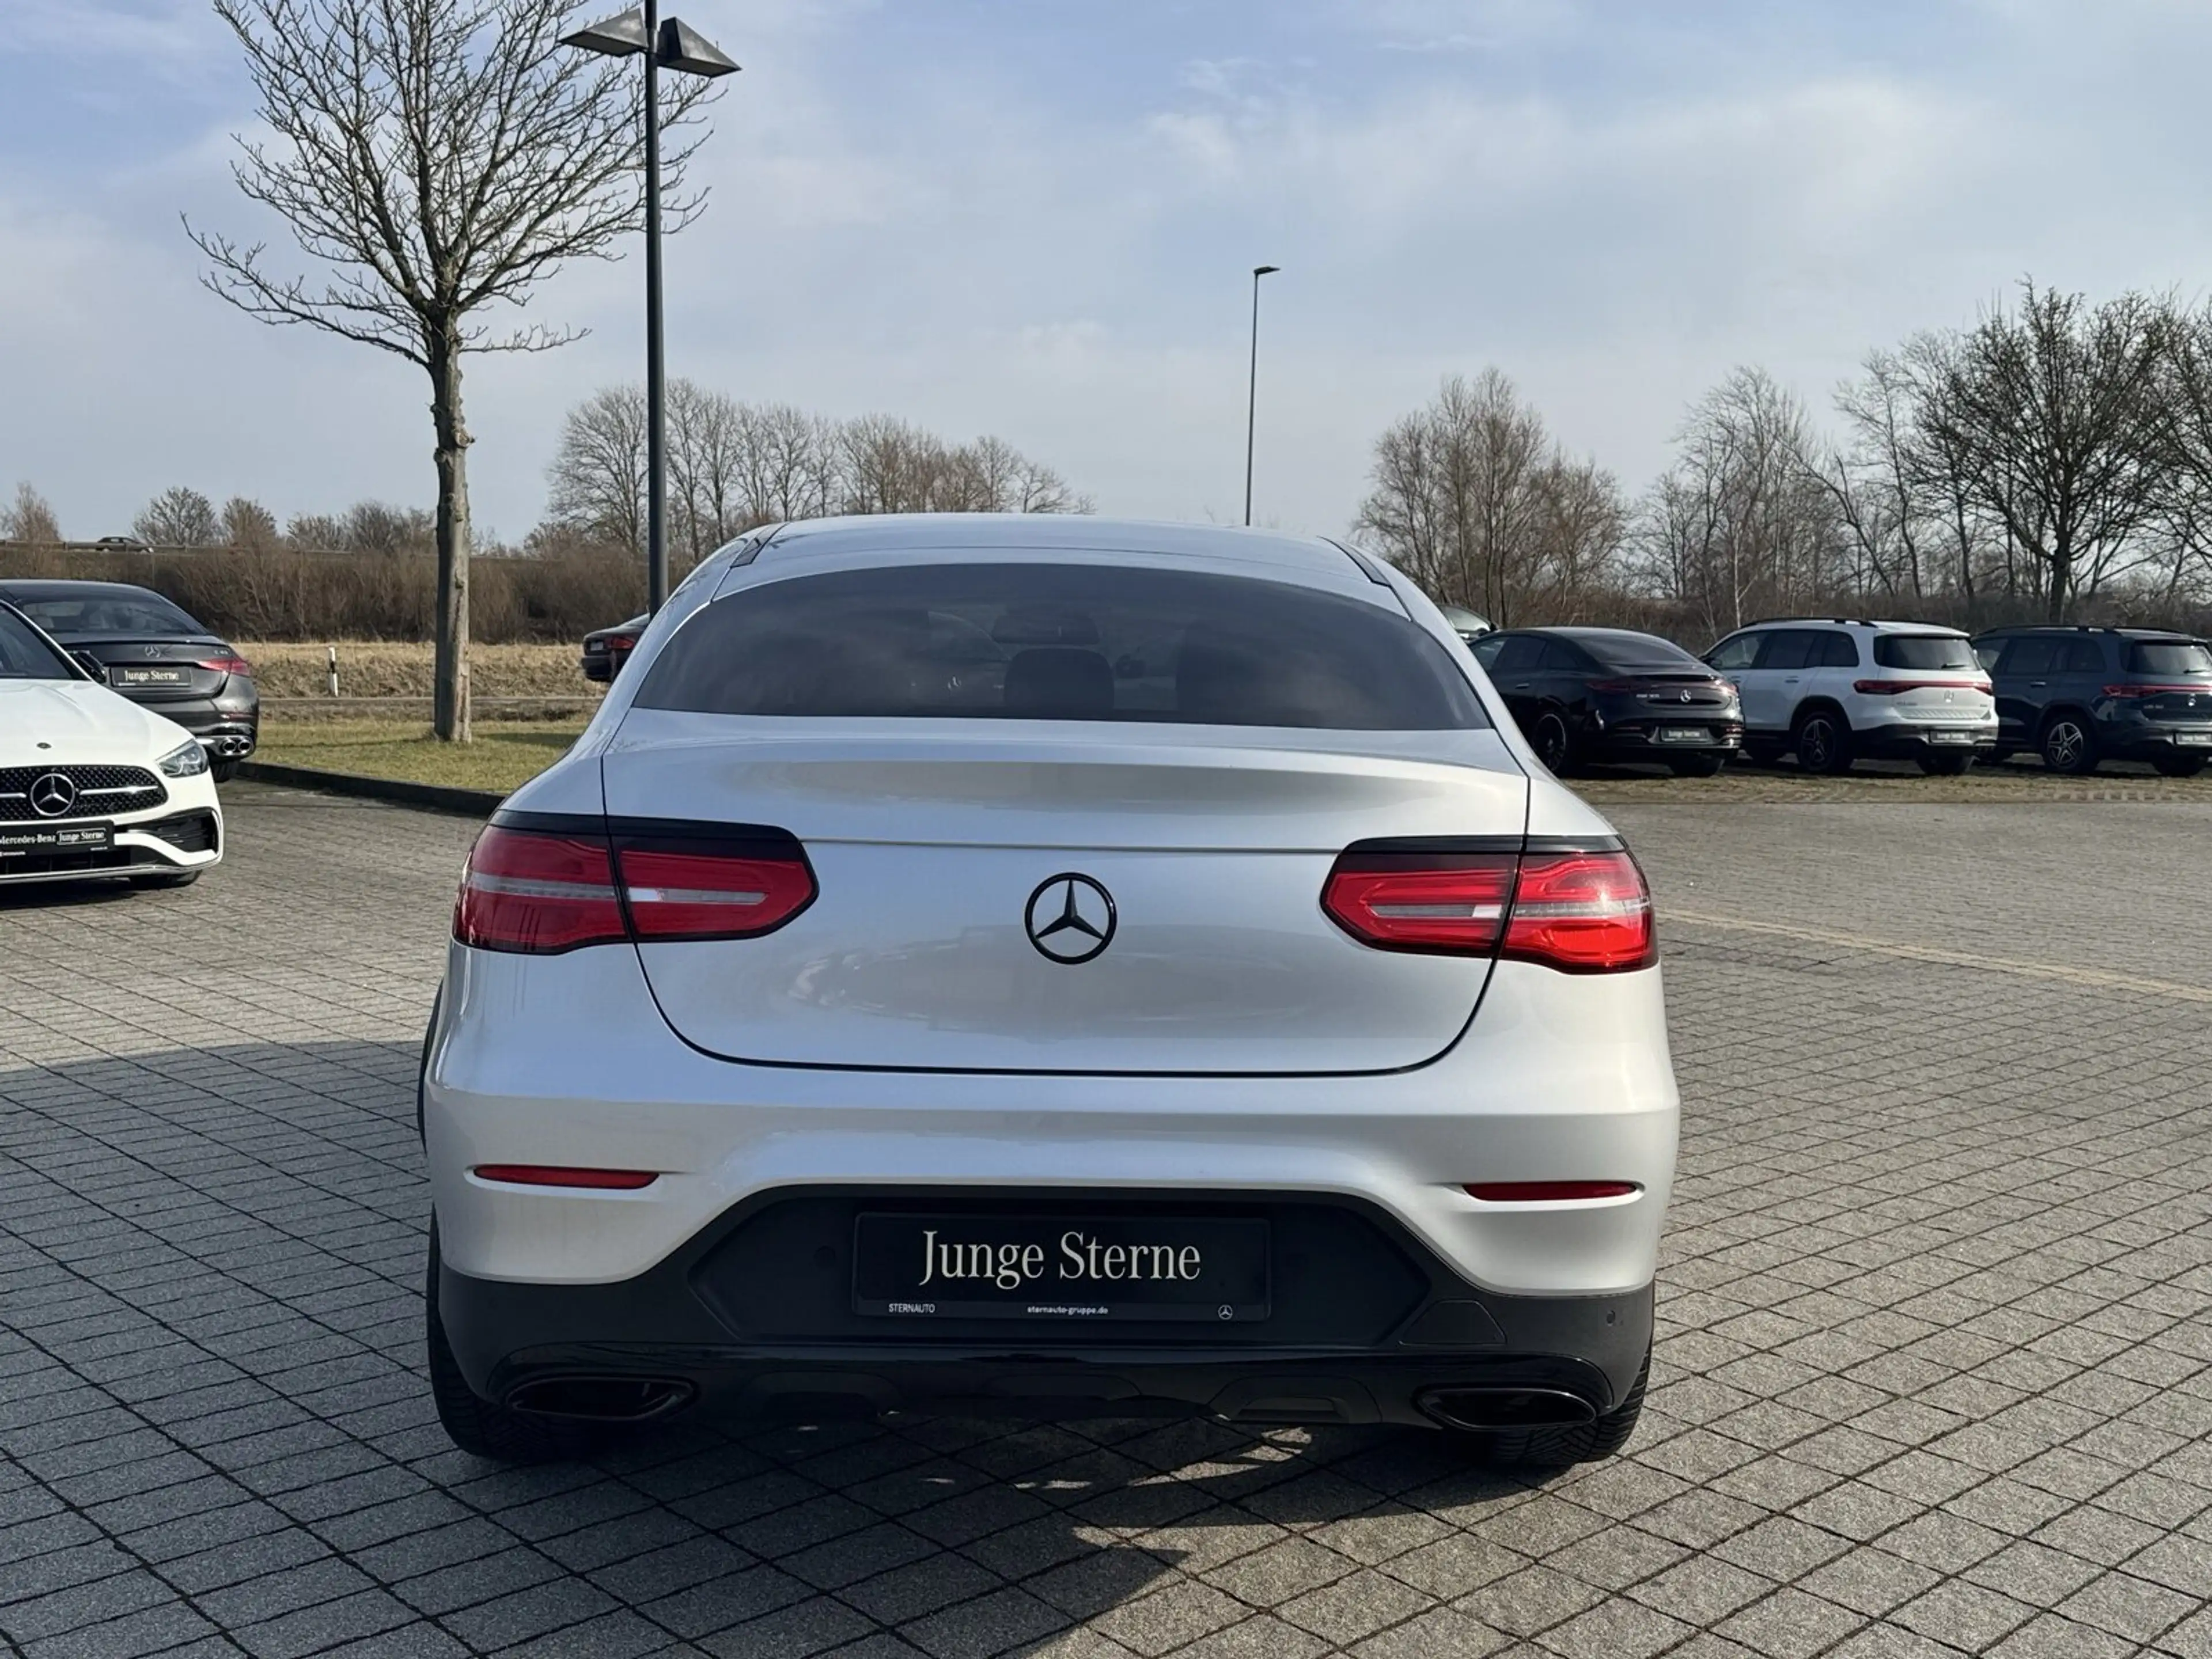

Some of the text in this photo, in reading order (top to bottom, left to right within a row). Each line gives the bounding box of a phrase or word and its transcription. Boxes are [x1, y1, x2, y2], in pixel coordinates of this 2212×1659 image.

[124, 670, 179, 681] Junge Sterne
[919, 1230, 1201, 1290] Junge Sterne
[888, 1303, 935, 1313] STERNAUTO
[1027, 1306, 1109, 1316] sternauto-gruppe.de
